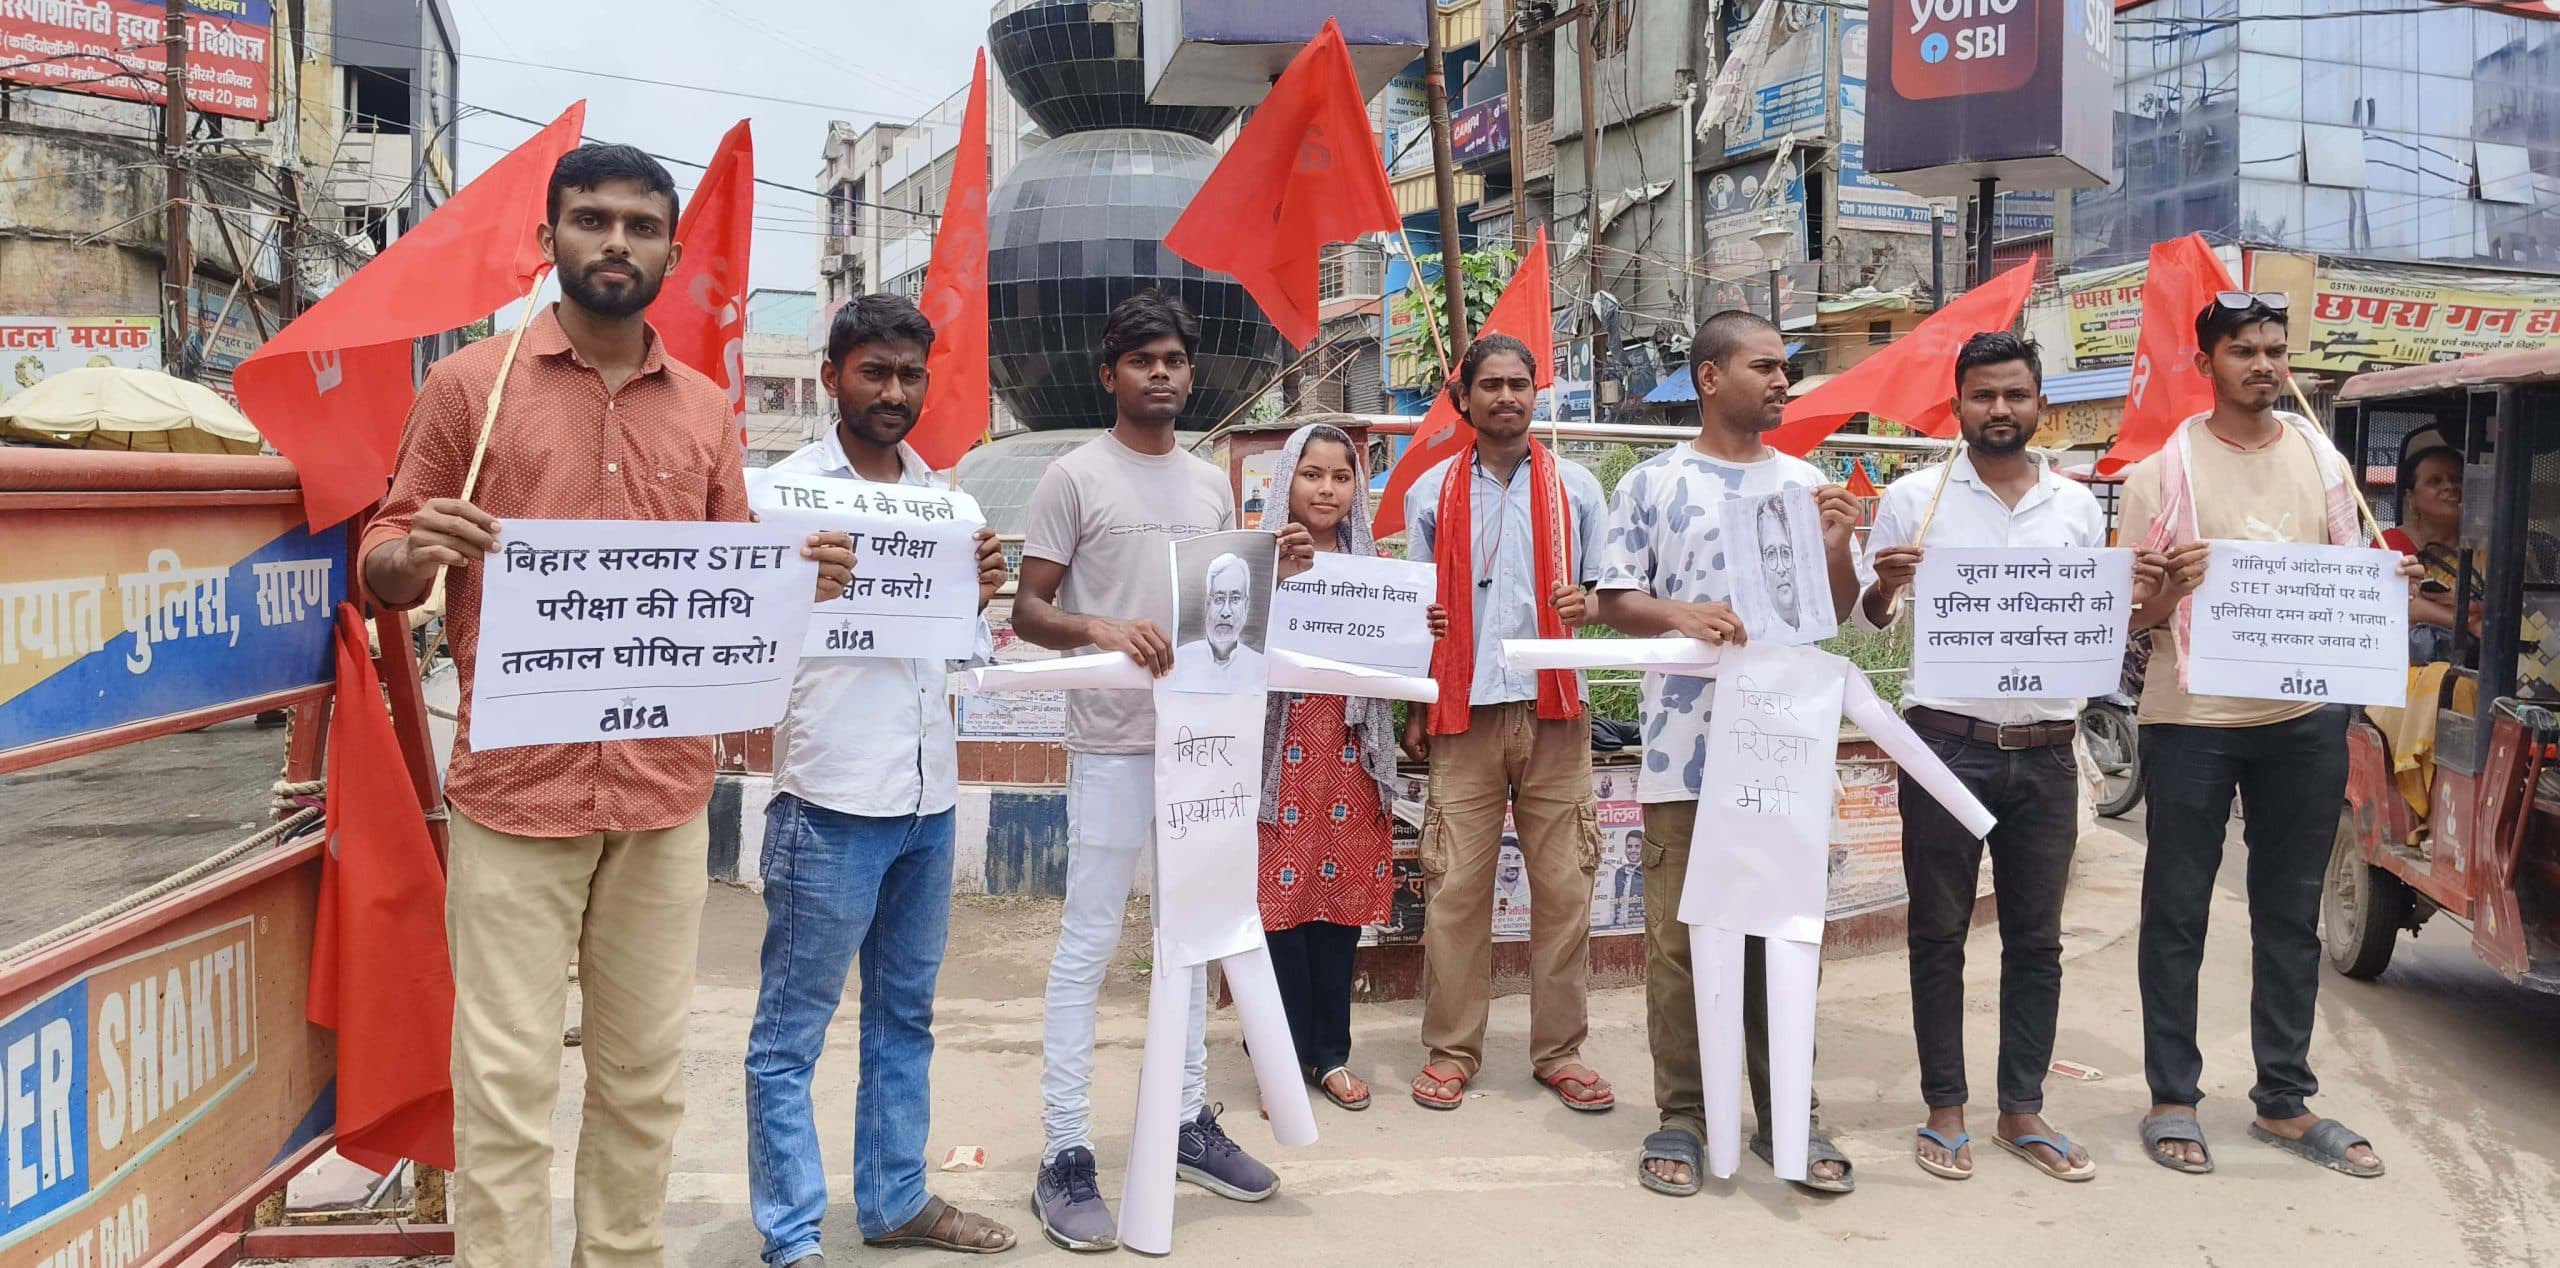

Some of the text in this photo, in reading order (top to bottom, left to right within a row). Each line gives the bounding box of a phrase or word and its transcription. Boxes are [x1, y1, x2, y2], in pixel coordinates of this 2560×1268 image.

[1955, 25, 2005, 60] SBI
[217, 69, 253, 89] शनिवार
[216, 89, 232, 105] 2D
[2314, 293, 2438, 329] छपरा
[2446, 304, 2522, 334] गन
[68, 319, 151, 349] मयंक
[1553, 346, 1568, 358] ABIB
[774, 485, 828, 510] TRE
[853, 493, 868, 513] 4
[873, 490, 897, 516] के
[903, 496, 954, 522] पहले
[504, 541, 791, 577] बिहार सरकार STET
[871, 530, 938, 559] परीक्षा
[1957, 558, 2098, 585] जूता मारने वाले
[2232, 555, 2380, 579] शांतिपूर्ण आंदोलन कर रहे
[881, 572, 932, 600] करो!
[1330, 580, 1380, 601] प्रतिरोध
[1383, 585, 1418, 604] दिवस
[2230, 581, 2271, 595] STET
[2340, 588, 2356, 601] पर
[118, 548, 241, 675] पुलिस,
[252, 558, 333, 627] सारण
[537, 588, 754, 622] परीक्षा की तिथि
[1933, 590, 2115, 619] पुलिस अधिकारी को
[2211, 603, 2271, 620] पुलिसिया
[2276, 609, 2305, 622] दमन
[2308, 606, 2334, 624] क्यों
[2349, 612, 2388, 627] भाजपा
[826, 628, 874, 651] aisa
[1289, 617, 1386, 639] 8 अगस्त 2025
[1928, 624, 2114, 647] तत्काल बर्खास्त करो!
[2232, 630, 2267, 647] जदयू
[2271, 632, 2314, 647] सरकार
[2318, 634, 2356, 649] जवाब
[502, 636, 778, 675] तत्काल घोषित करो!
[1736, 675, 1799, 721] बिहार
[1997, 675, 2043, 693] aisa
[2280, 675, 2329, 696] aisa
[600, 703, 669, 733] aisa
[1174, 725, 1236, 767] बिहार
[1736, 776, 1801, 816] मंत्री
[1168, 782, 1253, 840] मुख्यमंत्री
[0, 940, 249, 1209] ER SHAKTI
[100, 1193, 150, 1268] BAR
